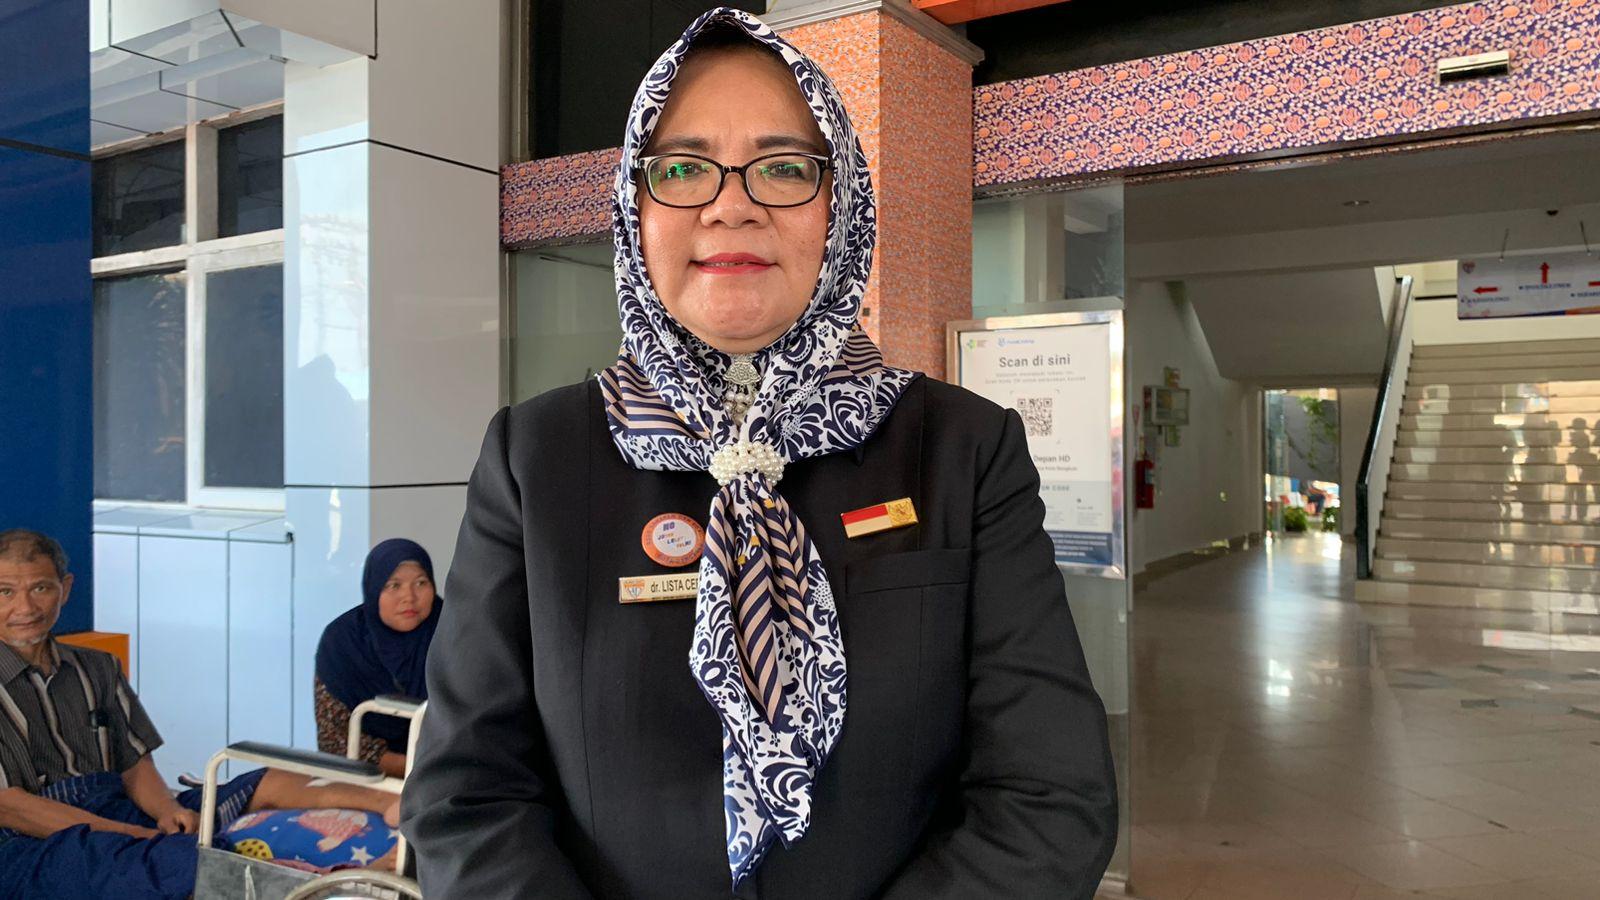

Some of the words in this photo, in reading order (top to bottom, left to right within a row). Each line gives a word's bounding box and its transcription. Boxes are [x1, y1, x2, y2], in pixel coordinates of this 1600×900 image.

[999, 356, 1029, 368] Scan
[1032, 355, 1044, 367] di
[1047, 353, 1072, 366] sini
[1058, 455, 1071, 463] HD
[651, 581, 660, 593] dr.
[661, 579, 684, 592] LISTA
